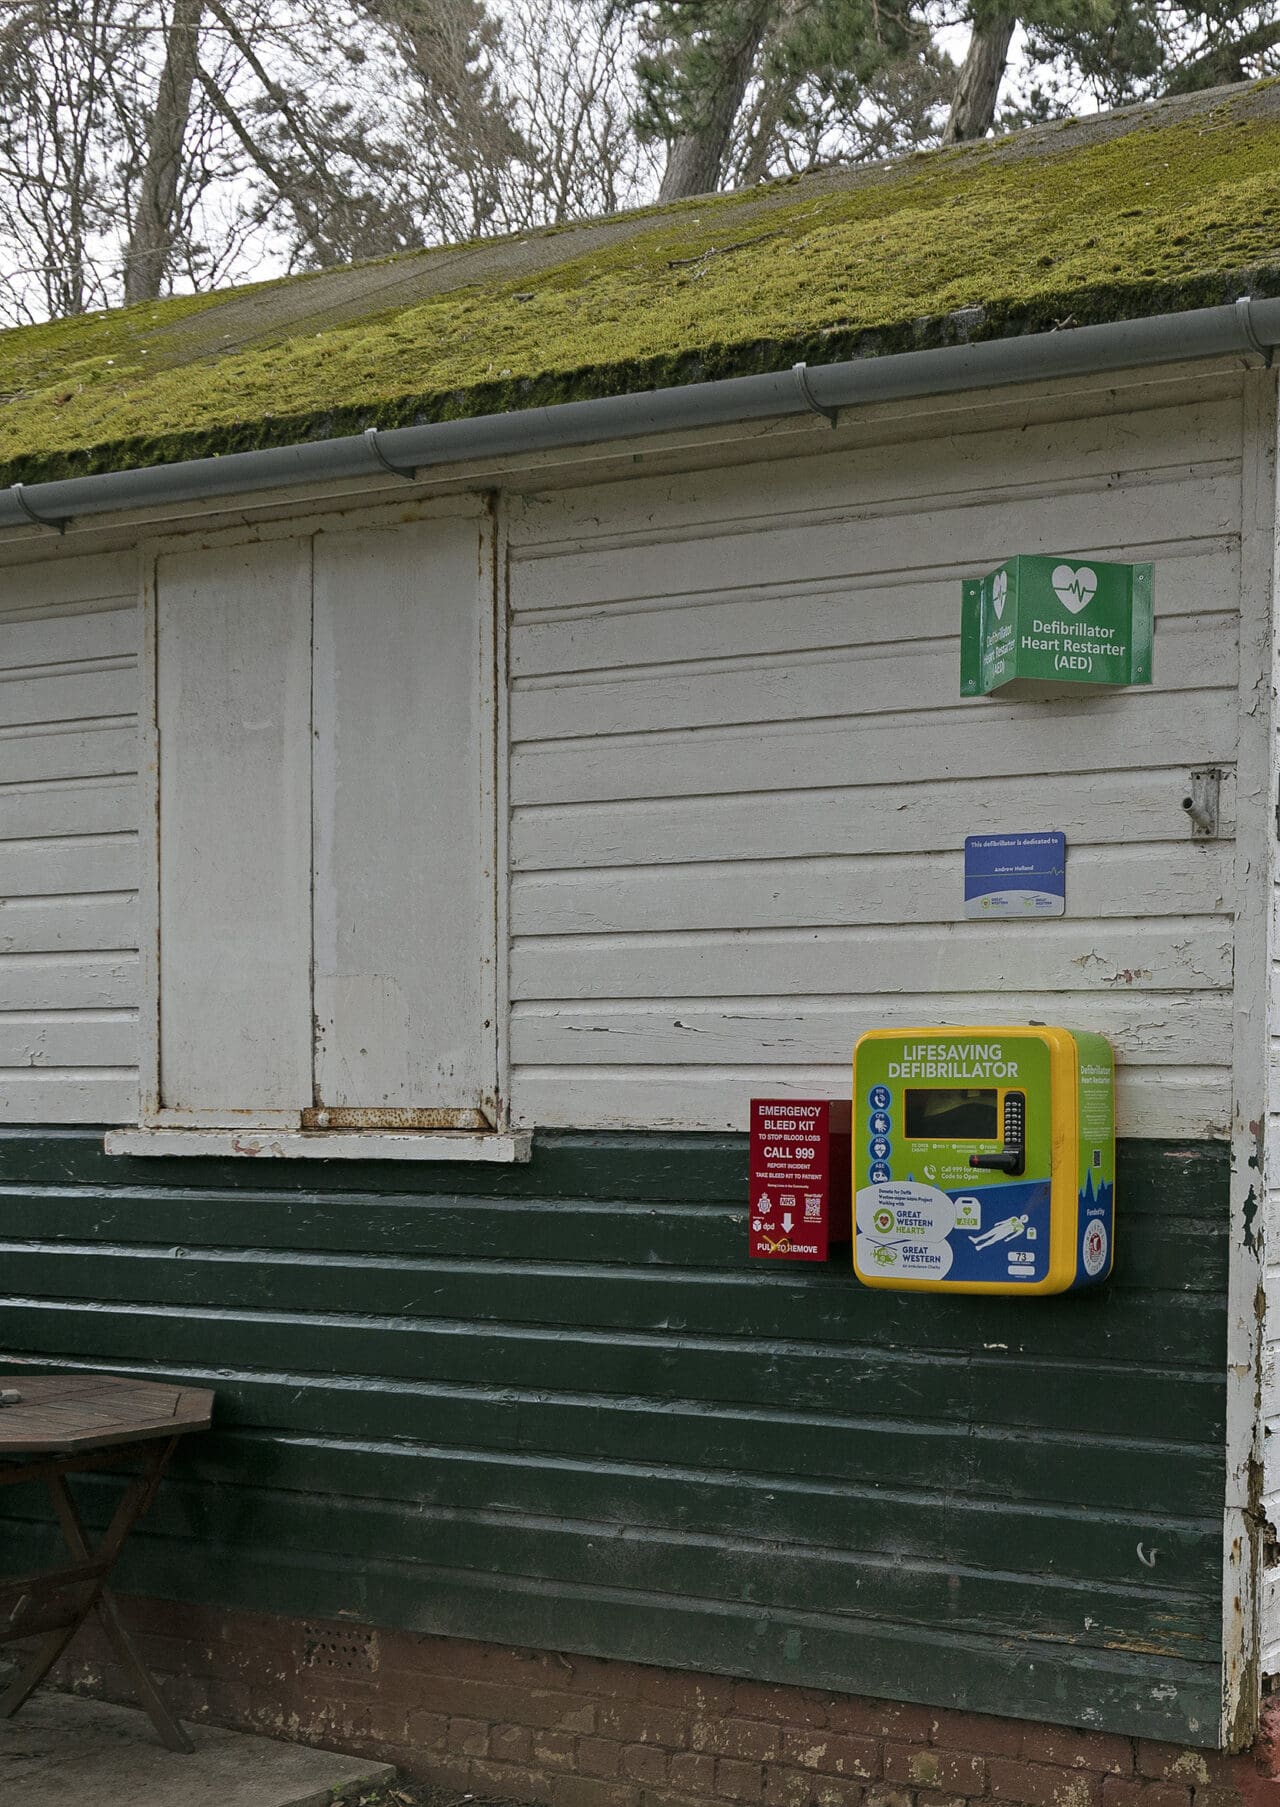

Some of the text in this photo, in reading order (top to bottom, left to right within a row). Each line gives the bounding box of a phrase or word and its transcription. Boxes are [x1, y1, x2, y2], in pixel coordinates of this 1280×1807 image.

[1033, 620, 1115, 638] Defibrillator
[1021, 636, 1126, 656] Heart Restarter
[1054, 654, 1093, 673] (AED)
[903, 1044, 1002, 1060] LIFESAVING
[888, 1061, 1018, 1078] DEFIBRILLATOR
[758, 1105, 821, 1117] EMERGENCY
[764, 1120, 816, 1131] BLEED KIT
[763, 1146, 815, 1159] CALL 999
[963, 1173, 978, 1181] Open
[896, 1210, 921, 1218] GREAT
[896, 1219, 933, 1227] WESTERN
[960, 1218, 976, 1226] AED
[763, 1222, 775, 1231] dpd
[896, 1227, 926, 1235] HEARTS
[757, 1243, 776, 1251] PUL
[902, 1246, 929, 1254] GREAT
[902, 1255, 941, 1263] WESTERN
[1016, 1253, 1027, 1261] 73
